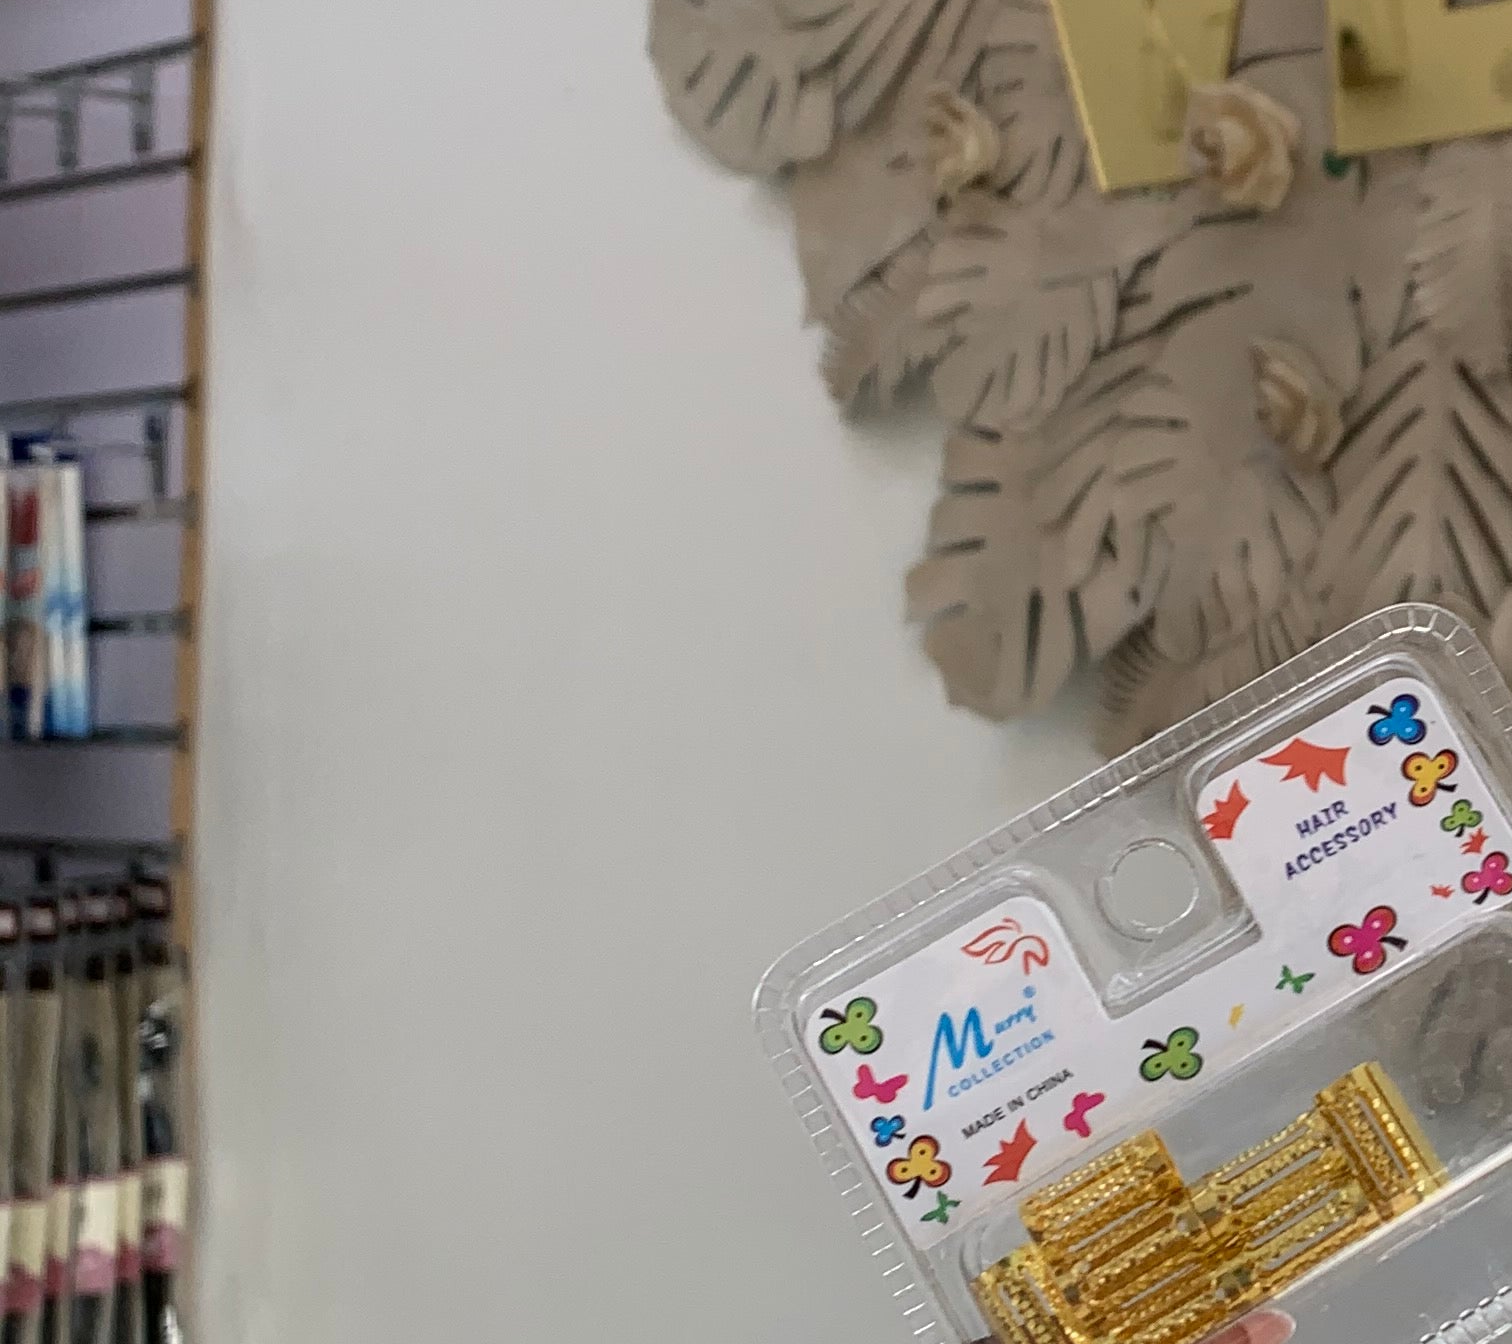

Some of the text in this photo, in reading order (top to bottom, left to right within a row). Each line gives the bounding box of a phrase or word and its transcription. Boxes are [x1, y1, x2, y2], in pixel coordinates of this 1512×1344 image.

[1284, 802, 1397, 880] ACCESSORY
[1295, 800, 1349, 838] HAIR
[948, 1029, 1055, 1097] COLLECTION
[961, 1068, 1074, 1139] MADE IN CHINA
